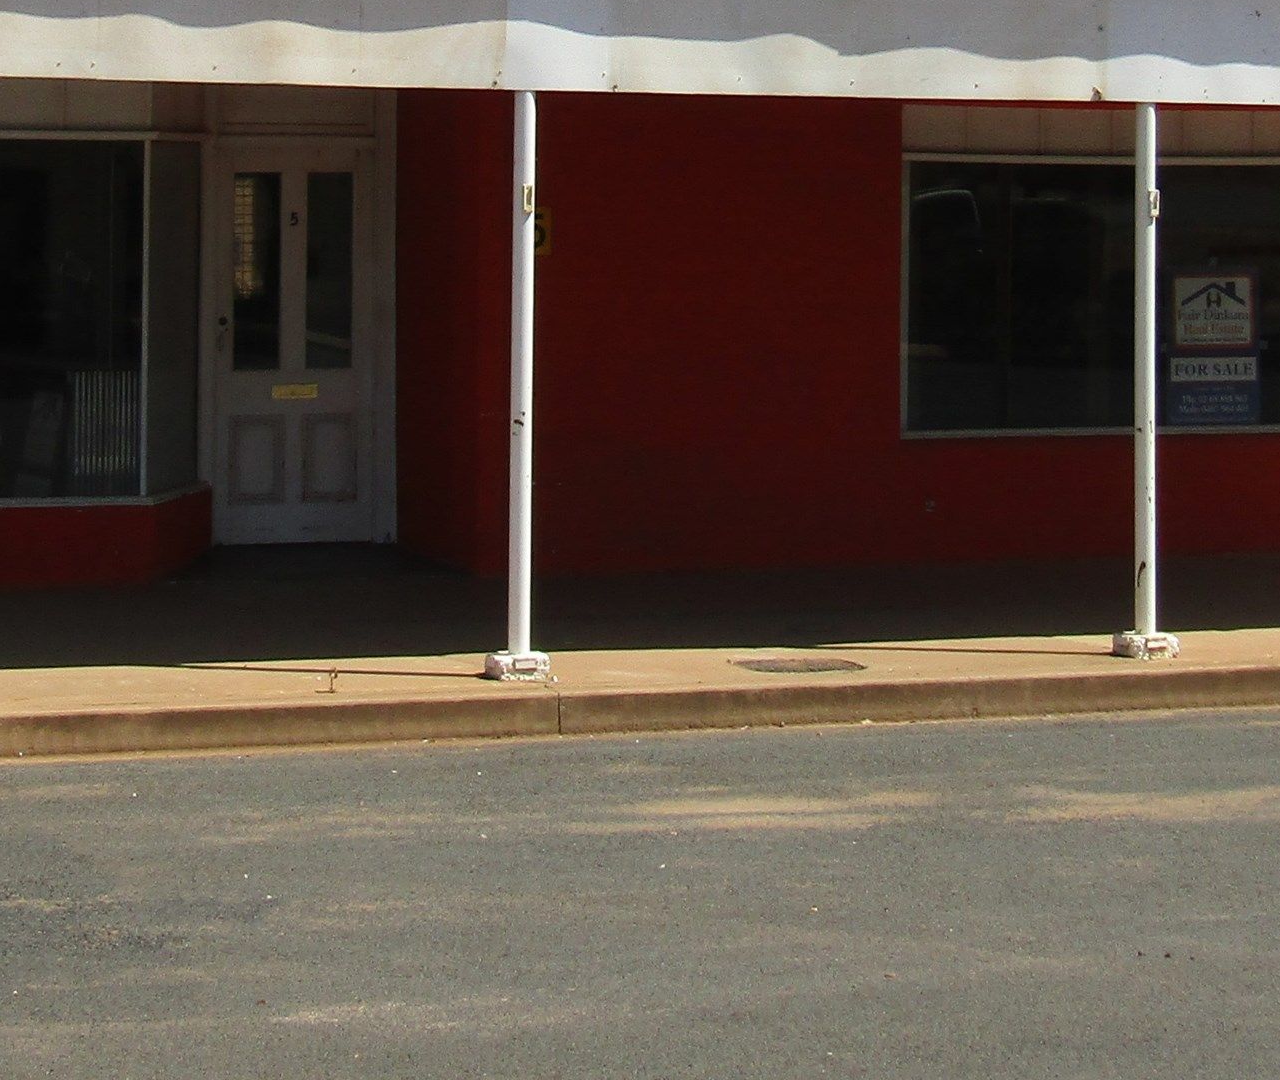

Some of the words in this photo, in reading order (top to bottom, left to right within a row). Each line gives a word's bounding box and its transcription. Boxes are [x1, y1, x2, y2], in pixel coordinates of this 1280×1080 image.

[290, 212, 299, 226] 5
[1174, 363, 1208, 376] FOR
[1213, 363, 1255, 376] SALE
